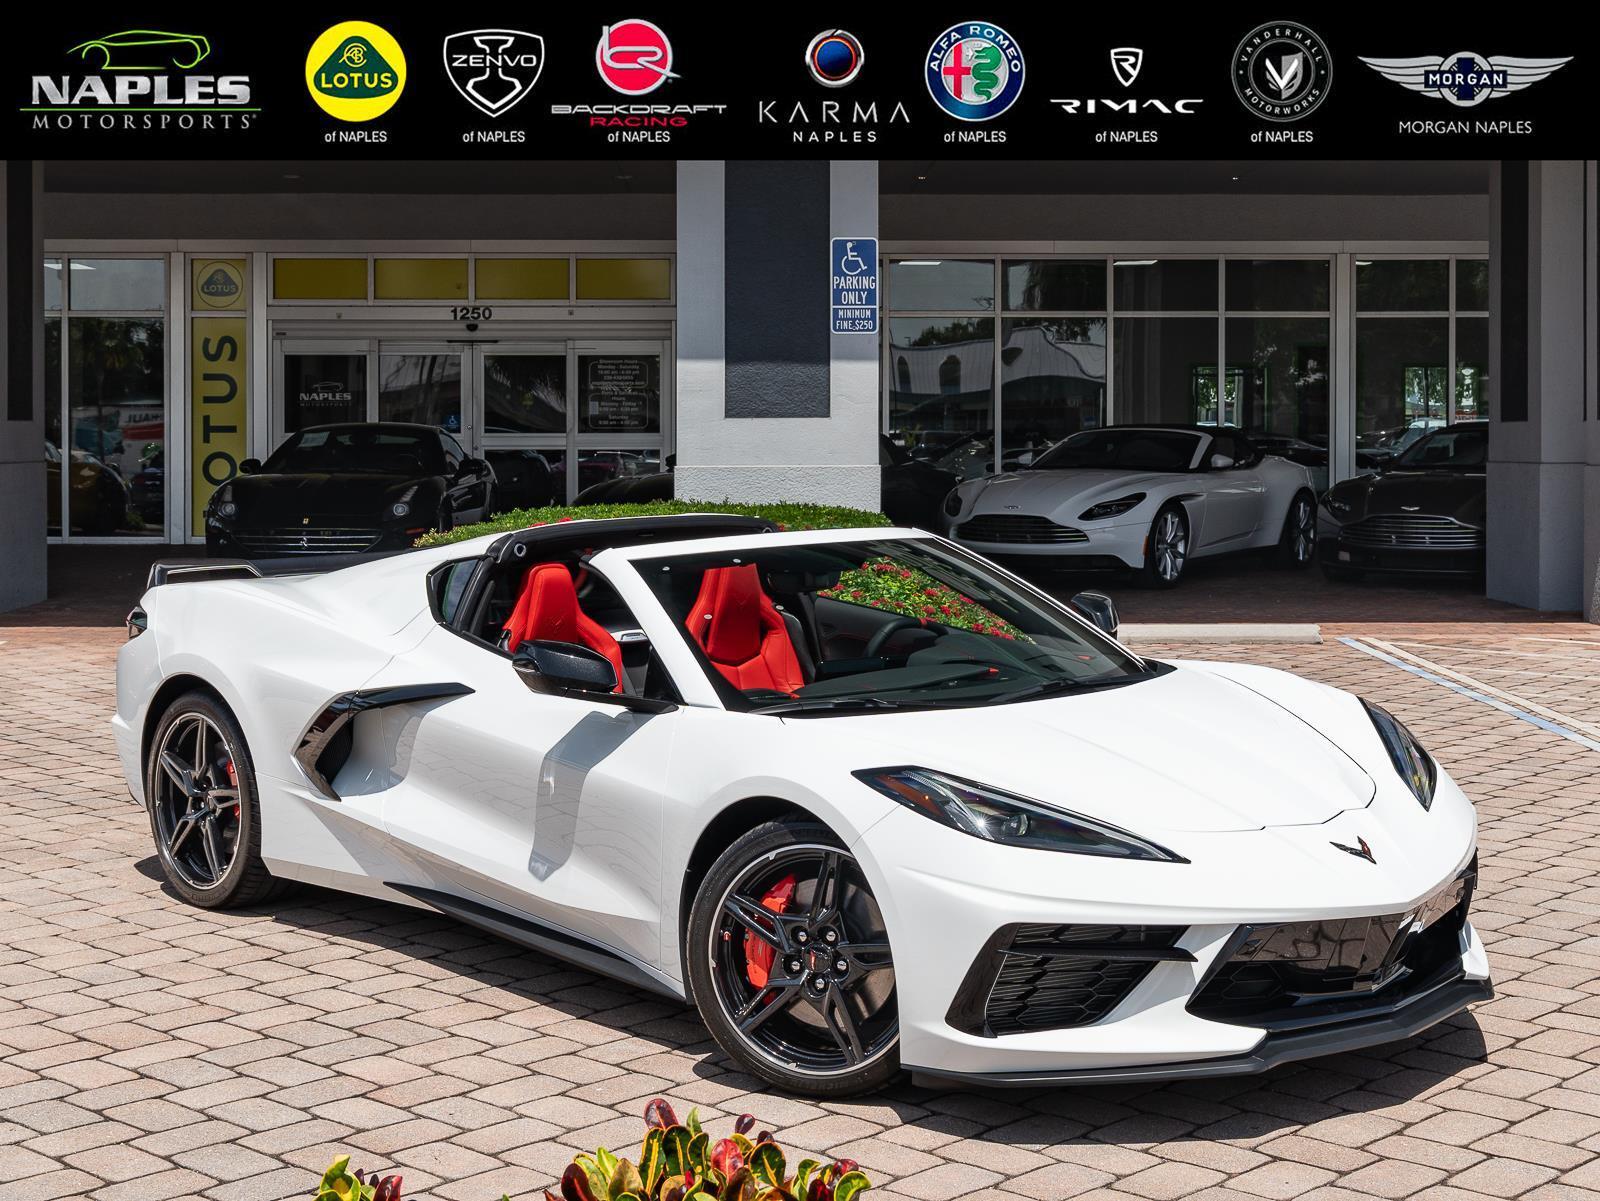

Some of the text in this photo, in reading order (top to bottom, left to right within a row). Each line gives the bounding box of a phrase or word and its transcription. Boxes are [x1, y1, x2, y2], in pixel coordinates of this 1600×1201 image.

[203, 284, 236, 293] LOTUS
[833, 276, 876, 289] PARKING
[841, 291, 868, 304] ONLY
[451, 307, 492, 320] 1250
[838, 309, 871, 319] MINIMUM
[836, 320, 873, 331] FINE $250
[299, 392, 352, 401] NAPLES
[202, 335, 238, 519] OTUS
